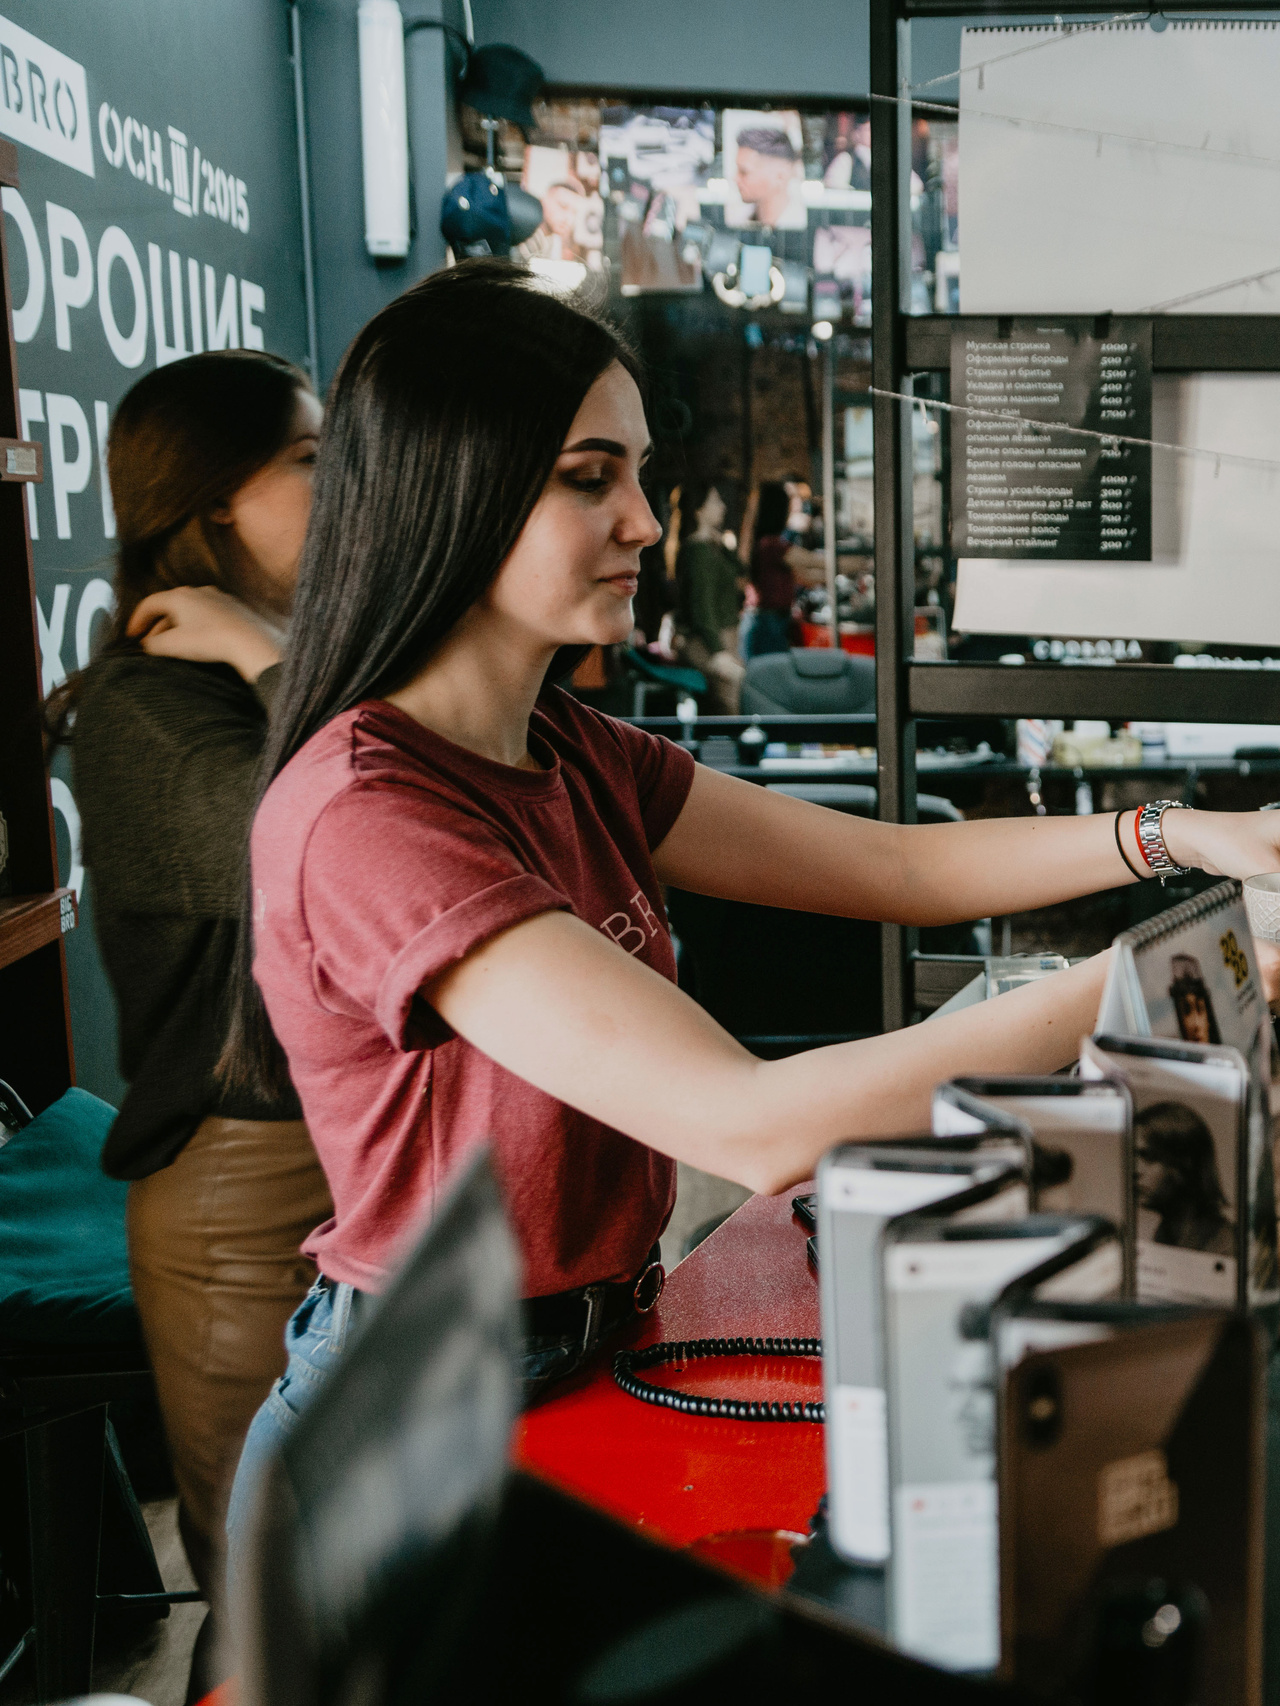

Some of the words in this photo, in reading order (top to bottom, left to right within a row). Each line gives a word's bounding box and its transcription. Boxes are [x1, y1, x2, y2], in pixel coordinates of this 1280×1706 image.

[966, 341, 1008, 351] Мужская
[1010, 342, 1050, 351] стрижка
[966, 354, 1029, 364] Оформление
[1031, 353, 1069, 364] бороды
[966, 367, 1008, 377] Стрижка
[1018, 367, 1051, 377] бритье
[966, 381, 1004, 390] Укладка
[1015, 382, 1064, 390] окантовка
[966, 394, 1008, 403] Стрижка
[1010, 394, 1060, 403] машинкой
[966, 420, 1030, 430] Оформлене
[966, 434, 1010, 442] опасным
[1011, 434, 1051, 442] лезвием
[966, 446, 1000, 456] Бритье
[1001, 447, 1045, 456] опасным
[1046, 448, 1087, 456] лезвием
[966, 459, 1000, 469] Бритье
[1002, 461, 1036, 469] головы
[1037, 461, 1081, 469] опасным
[966, 474, 1006, 482] лезвием
[966, 485, 1008, 495] Стрижка
[1010, 485, 1073, 496] усов/бороды
[966, 498, 1005, 508] Детская
[1006, 500, 1047, 509] стрижка
[1048, 500, 1061, 508] до
[1062, 499, 1074, 507] 12
[1075, 500, 1092, 508] лет
[967, 511, 1030, 521] Тонирование
[1031, 511, 1069, 522] бороды
[967, 524, 1030, 534] Тонирование
[1031, 526, 1060, 534] волос
[966, 537, 1013, 547] Вечерний
[1015, 537, 1058, 548] стайлинг
